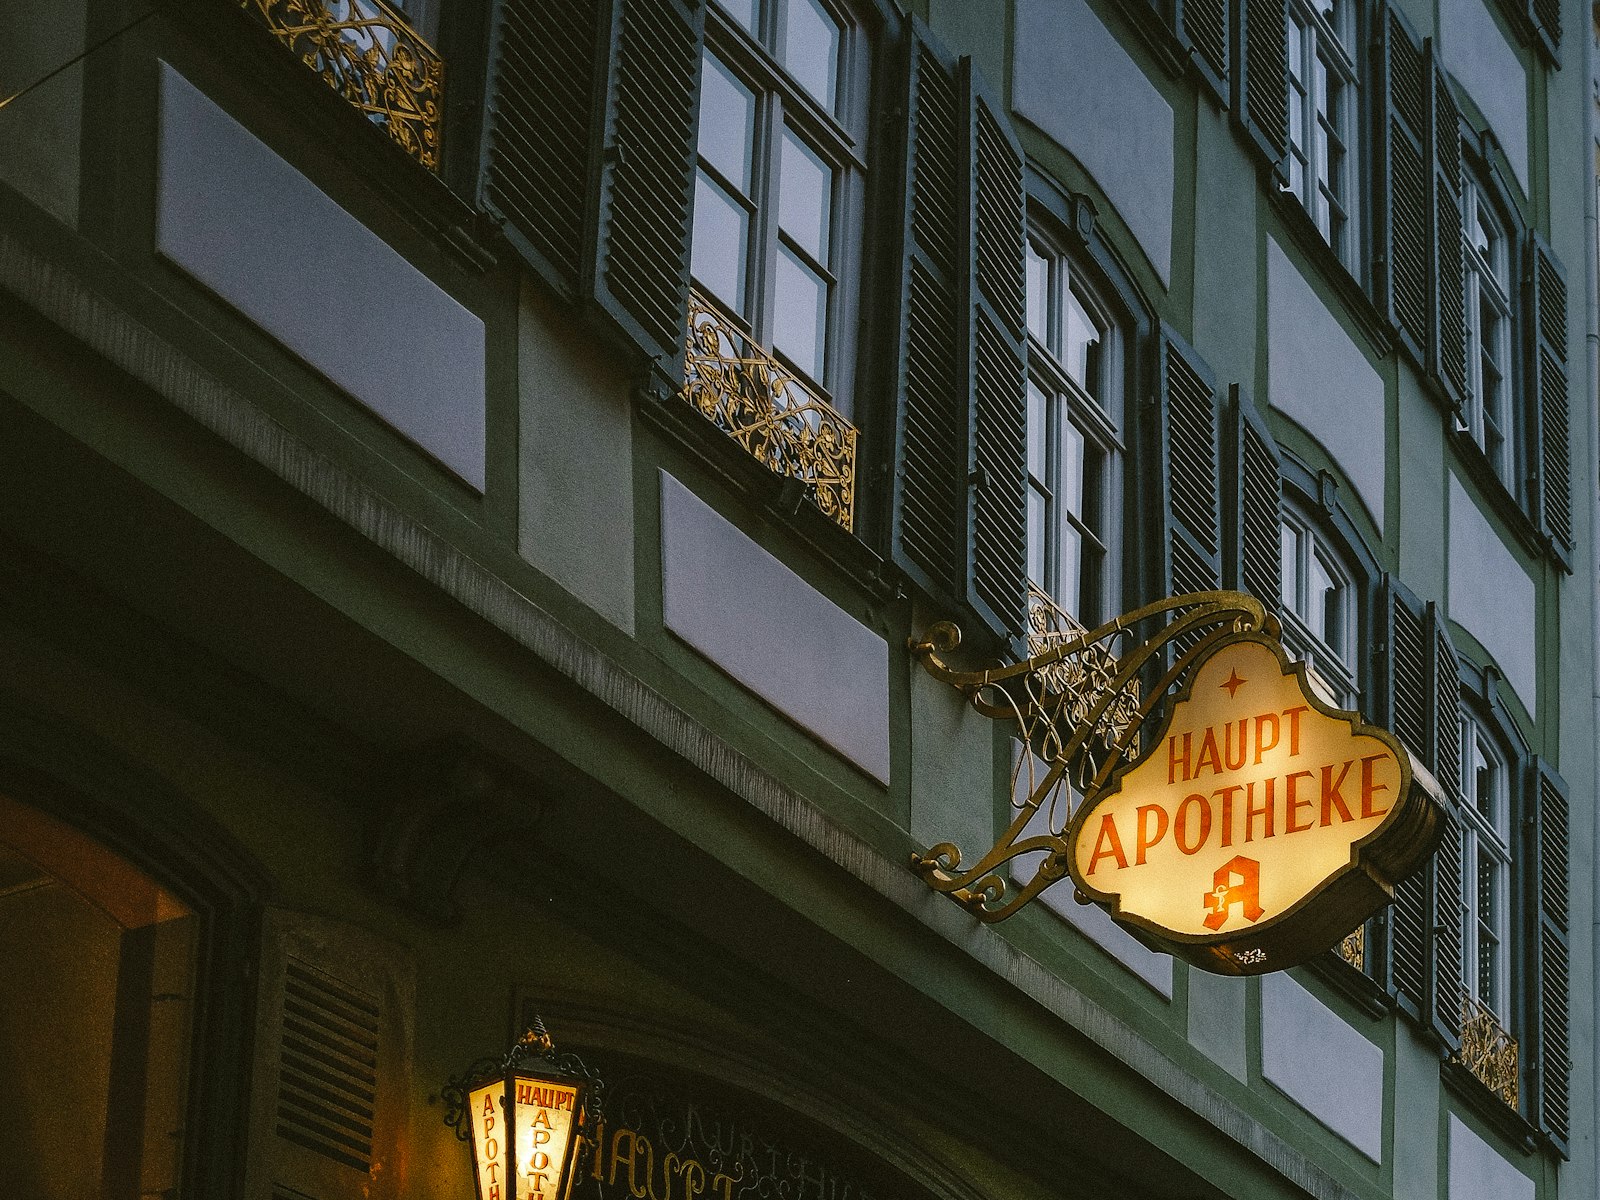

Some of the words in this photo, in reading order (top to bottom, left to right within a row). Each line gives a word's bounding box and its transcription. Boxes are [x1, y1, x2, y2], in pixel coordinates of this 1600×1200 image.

[1167, 705, 1310, 784] HAUPT
[1086, 753, 1391, 876] APOTHEKE
[516, 1084, 575, 1112] HAUPT
